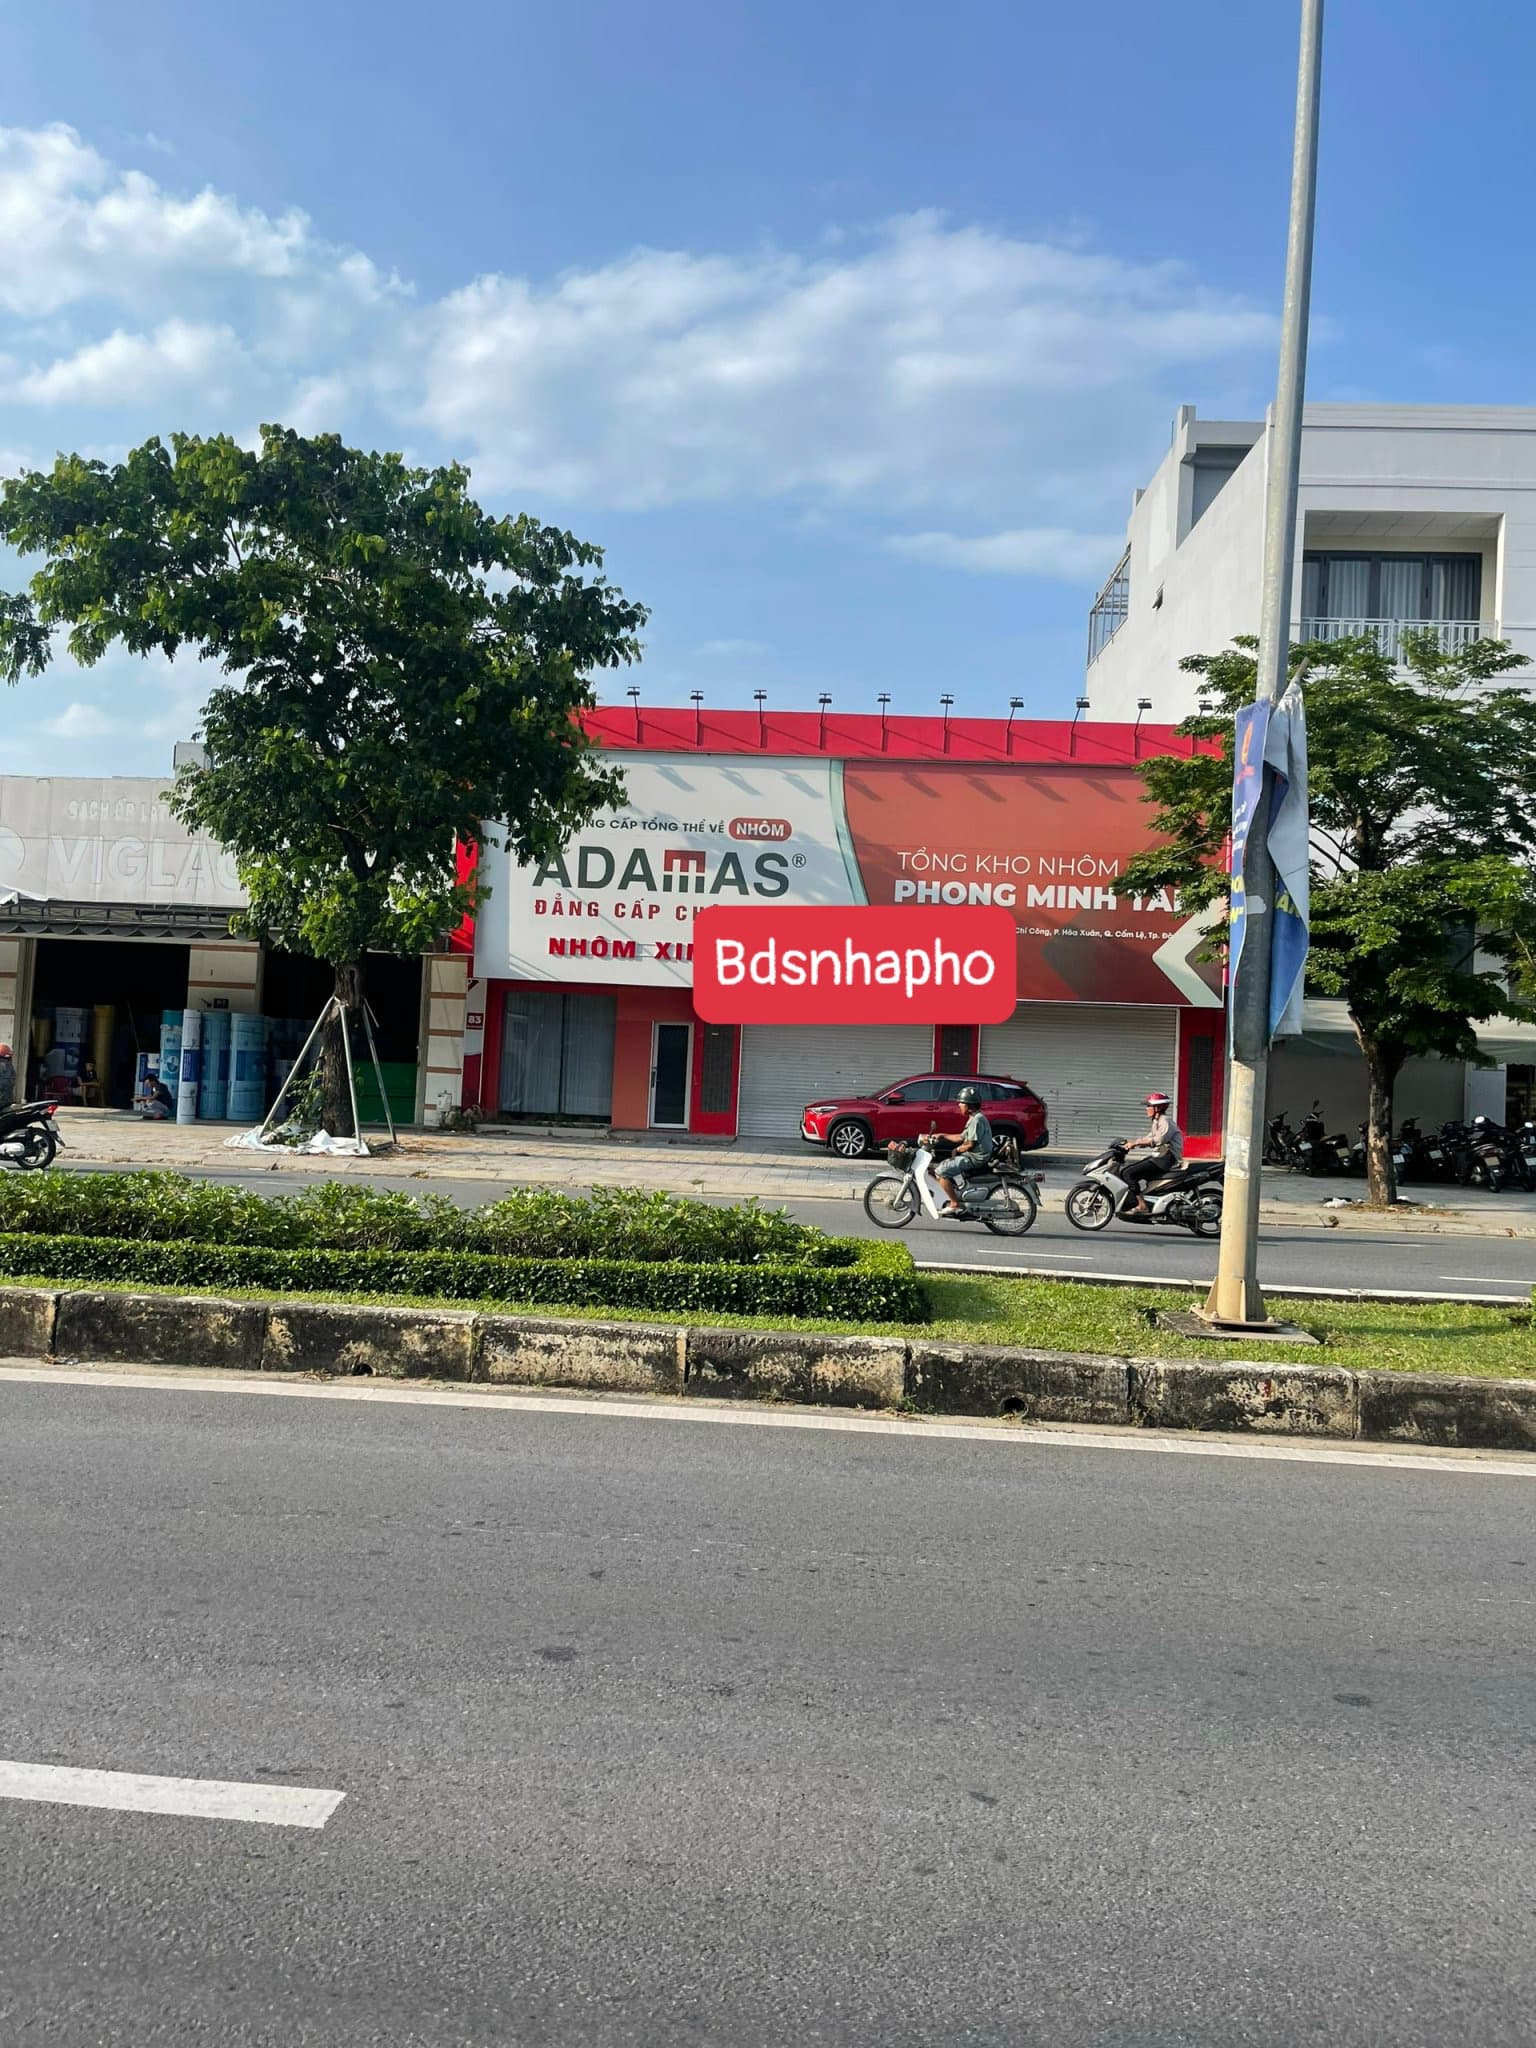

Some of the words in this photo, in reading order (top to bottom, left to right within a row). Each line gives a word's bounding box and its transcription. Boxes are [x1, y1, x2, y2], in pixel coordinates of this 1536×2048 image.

[609, 816, 638, 830] CẤP
[642, 816, 679, 832] TỔNG
[735, 818, 785, 837] NHÔM
[897, 847, 968, 874] TỔNG
[975, 855, 1031, 875] KHO
[1039, 854, 1119, 877] NHÔM
[534, 893, 599, 917] ĐẲNG
[614, 898, 661, 920] CẤP
[894, 879, 1016, 906] PHONG
[1027, 884, 1117, 911] MINH
[548, 936, 637, 960] NHÔM
